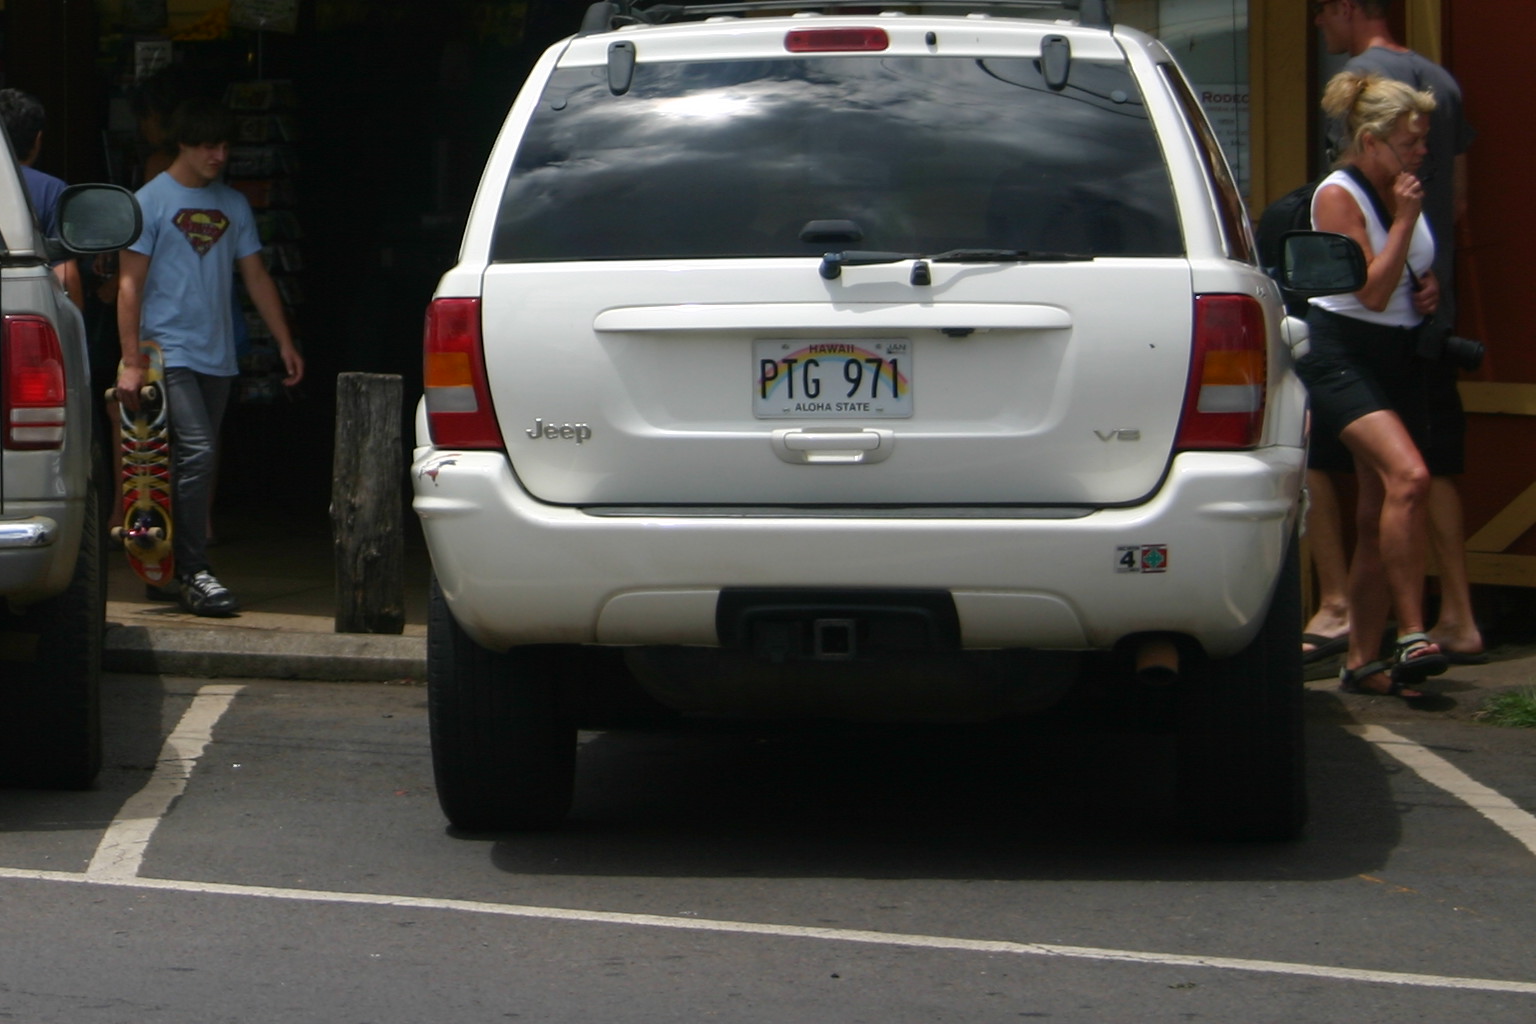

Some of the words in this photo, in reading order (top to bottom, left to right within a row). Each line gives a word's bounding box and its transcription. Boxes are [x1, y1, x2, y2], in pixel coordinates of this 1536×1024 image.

[809, 343, 855, 354] HAWAII
[760, 358, 821, 400] PTG
[843, 358, 898, 399] 971
[795, 402, 832, 412] ALOHA
[835, 402, 871, 412] STATE
[525, 417, 592, 446] Jeep
[1119, 550, 1136, 568] 4
